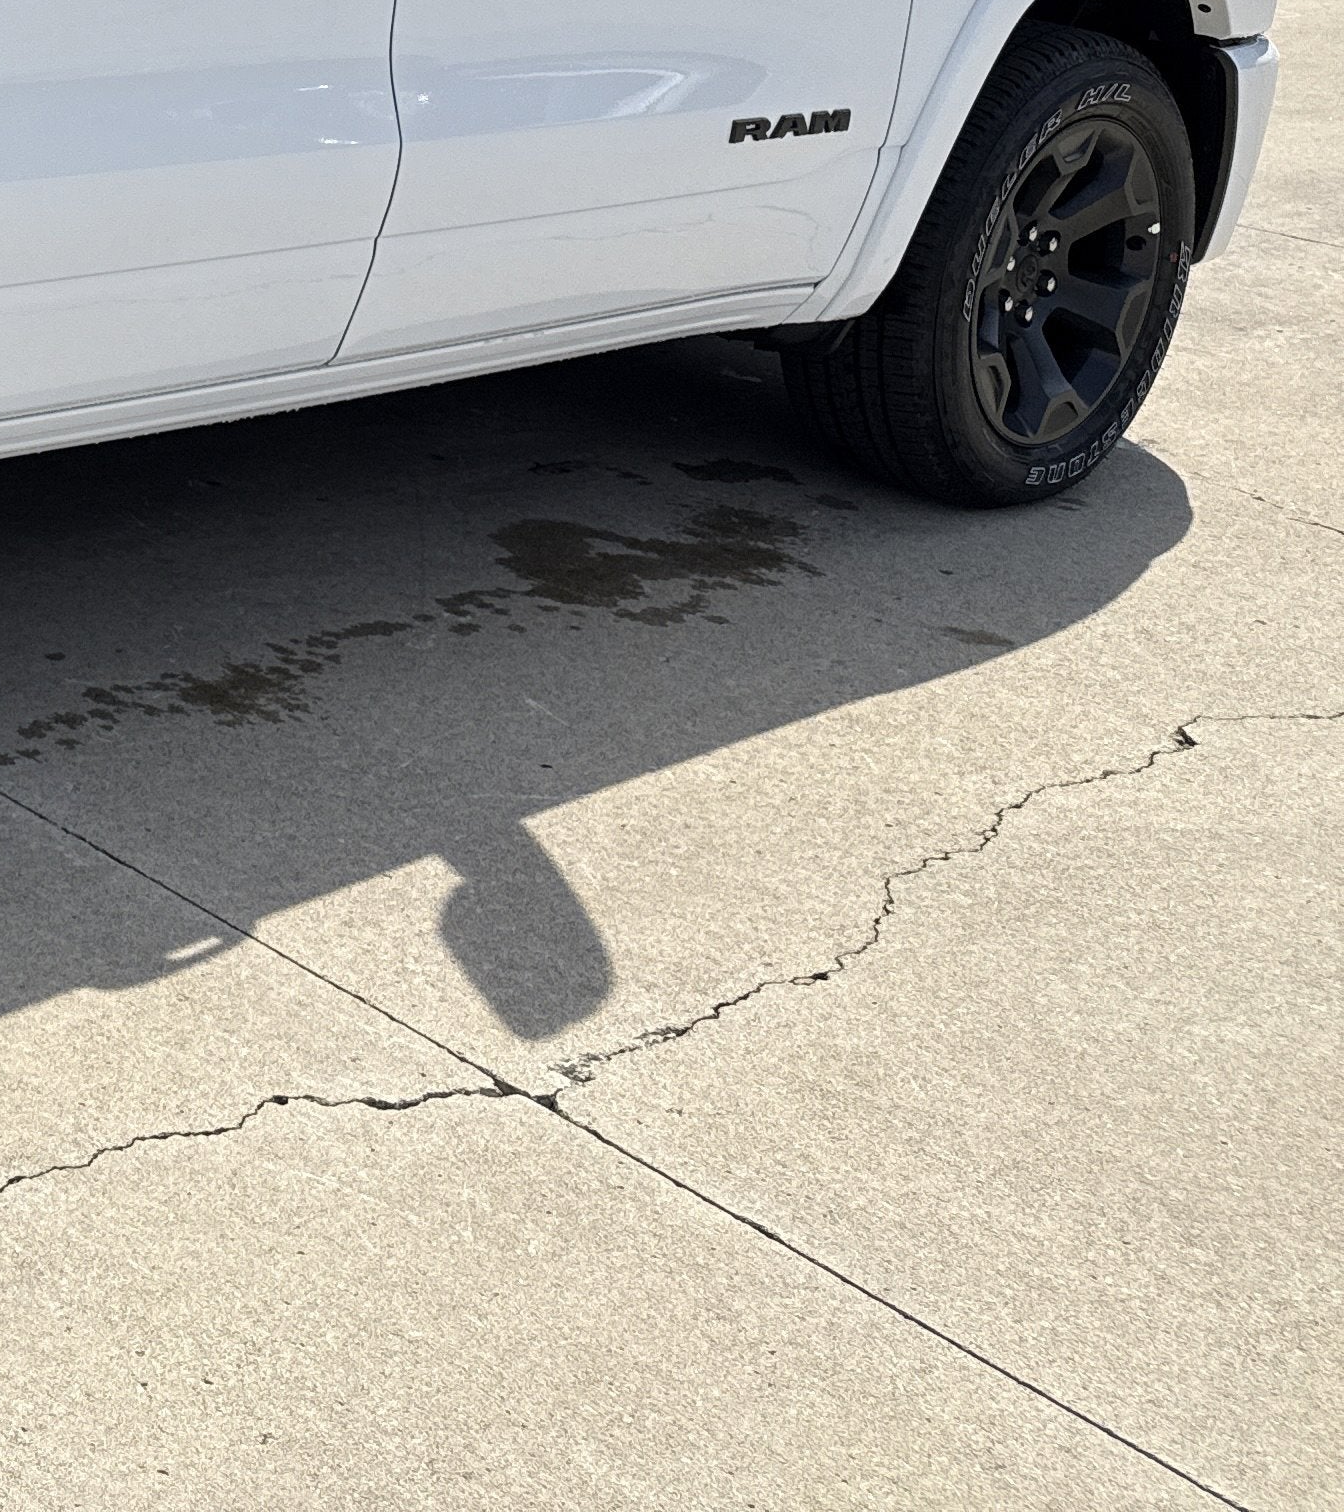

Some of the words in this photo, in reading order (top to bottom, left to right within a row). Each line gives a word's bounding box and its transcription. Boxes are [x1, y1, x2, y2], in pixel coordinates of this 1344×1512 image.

[1077, 82, 1132, 111] H/L
[728, 107, 852, 144] RAM
[1024, 240, 1193, 486] BRIDGESTONE
